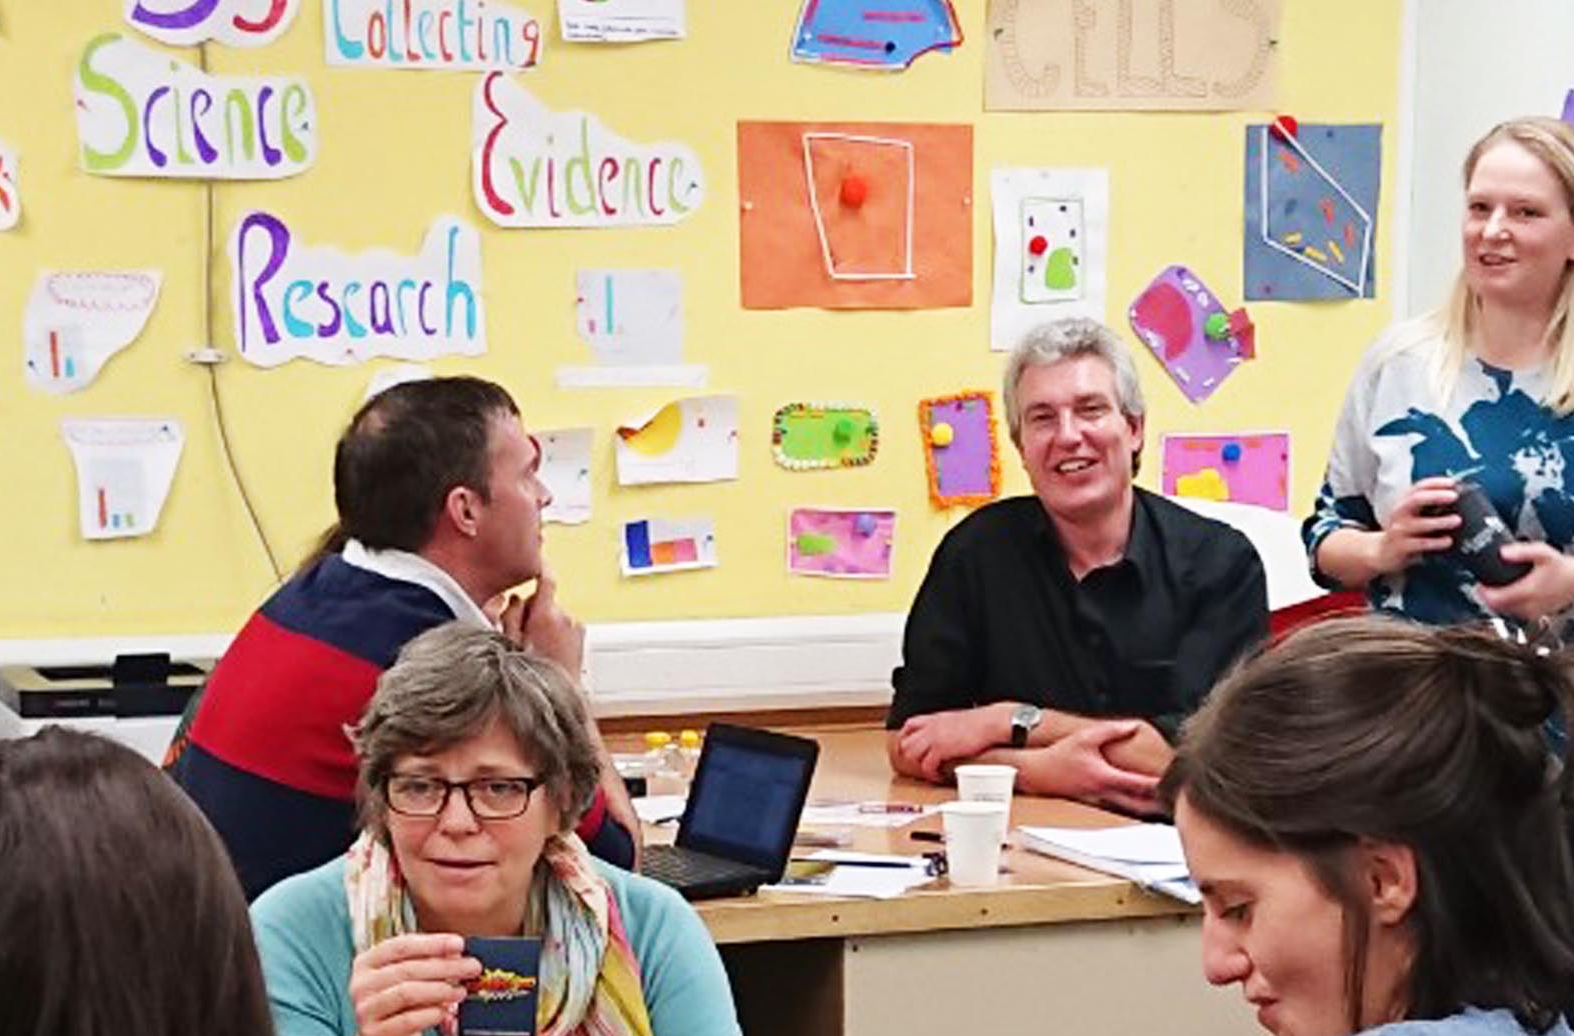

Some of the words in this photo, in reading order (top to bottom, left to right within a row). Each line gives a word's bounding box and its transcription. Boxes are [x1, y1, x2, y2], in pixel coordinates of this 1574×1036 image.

[79, 32, 306, 169] Science
[482, 71, 690, 217] Evidence
[238, 212, 475, 352] Research
